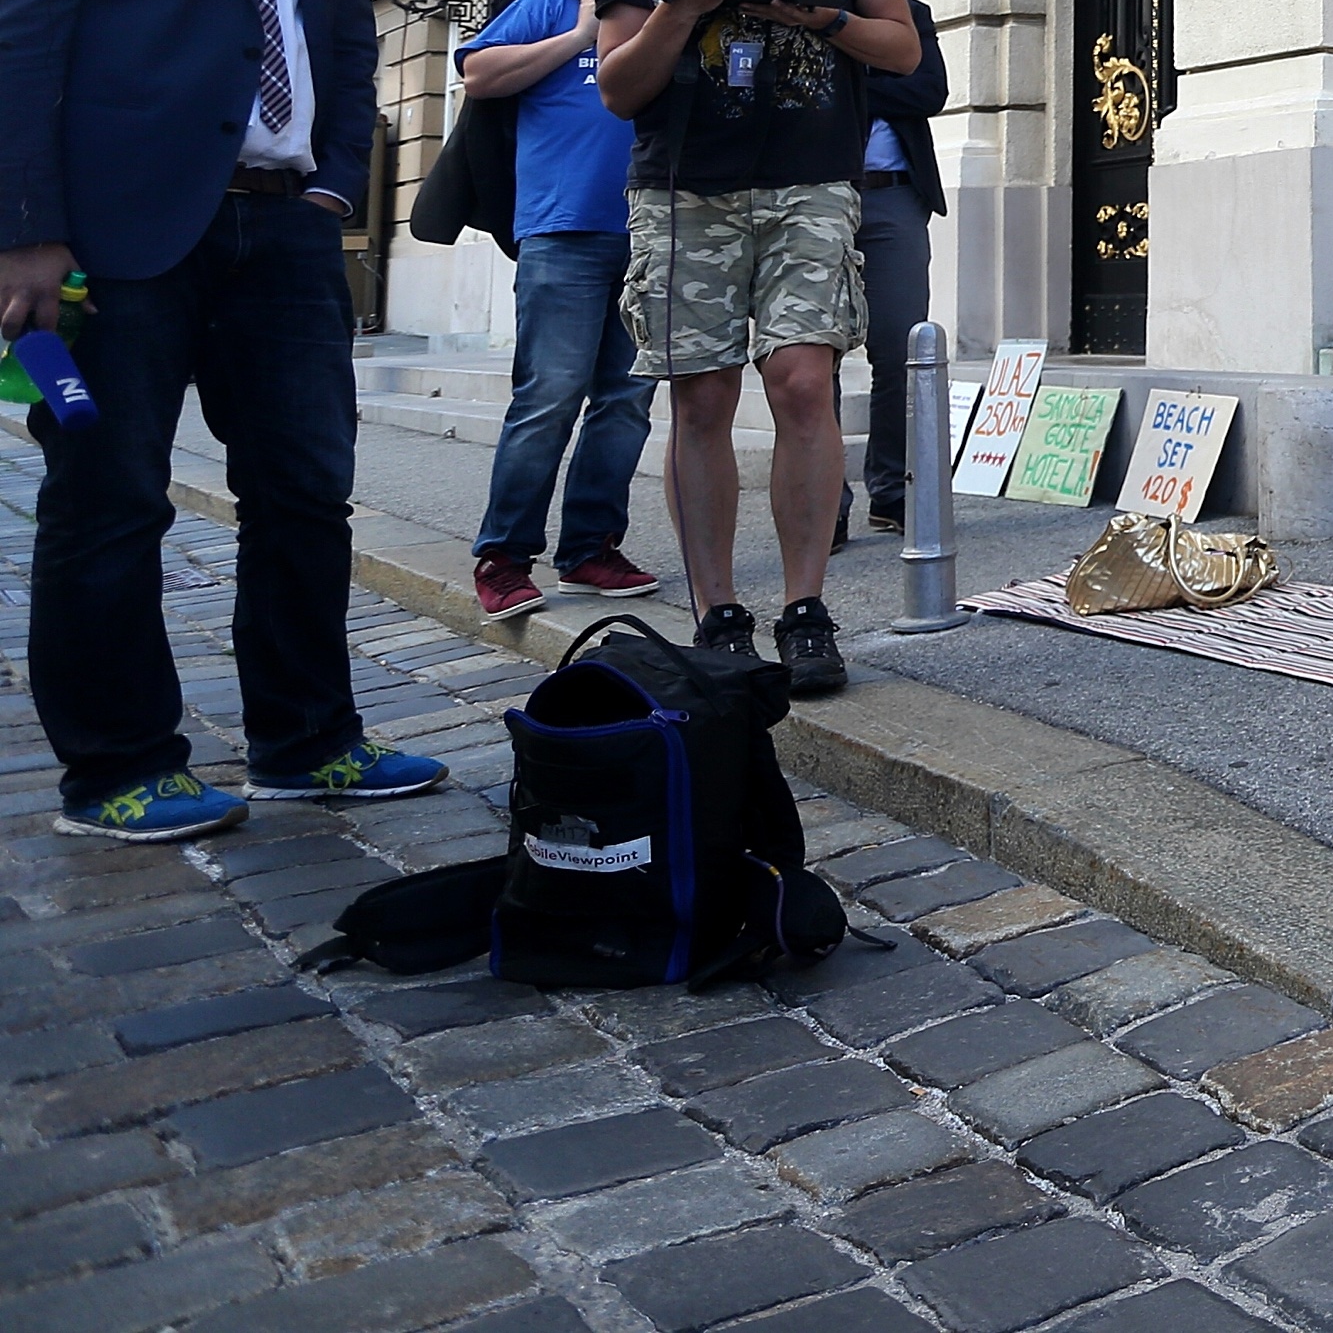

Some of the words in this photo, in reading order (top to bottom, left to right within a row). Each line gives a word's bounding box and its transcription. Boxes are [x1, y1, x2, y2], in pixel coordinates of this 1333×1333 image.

[988, 352, 1042, 398] ULAZ
[975, 401, 1025, 436] 250kn
[1152, 402, 1215, 436] BEACH
[1157, 438, 1193, 470] SET
[1020, 450, 1100, 497] HOTELA!
[1142, 475, 1177, 505] 120
[1176, 476, 1194, 515] $
